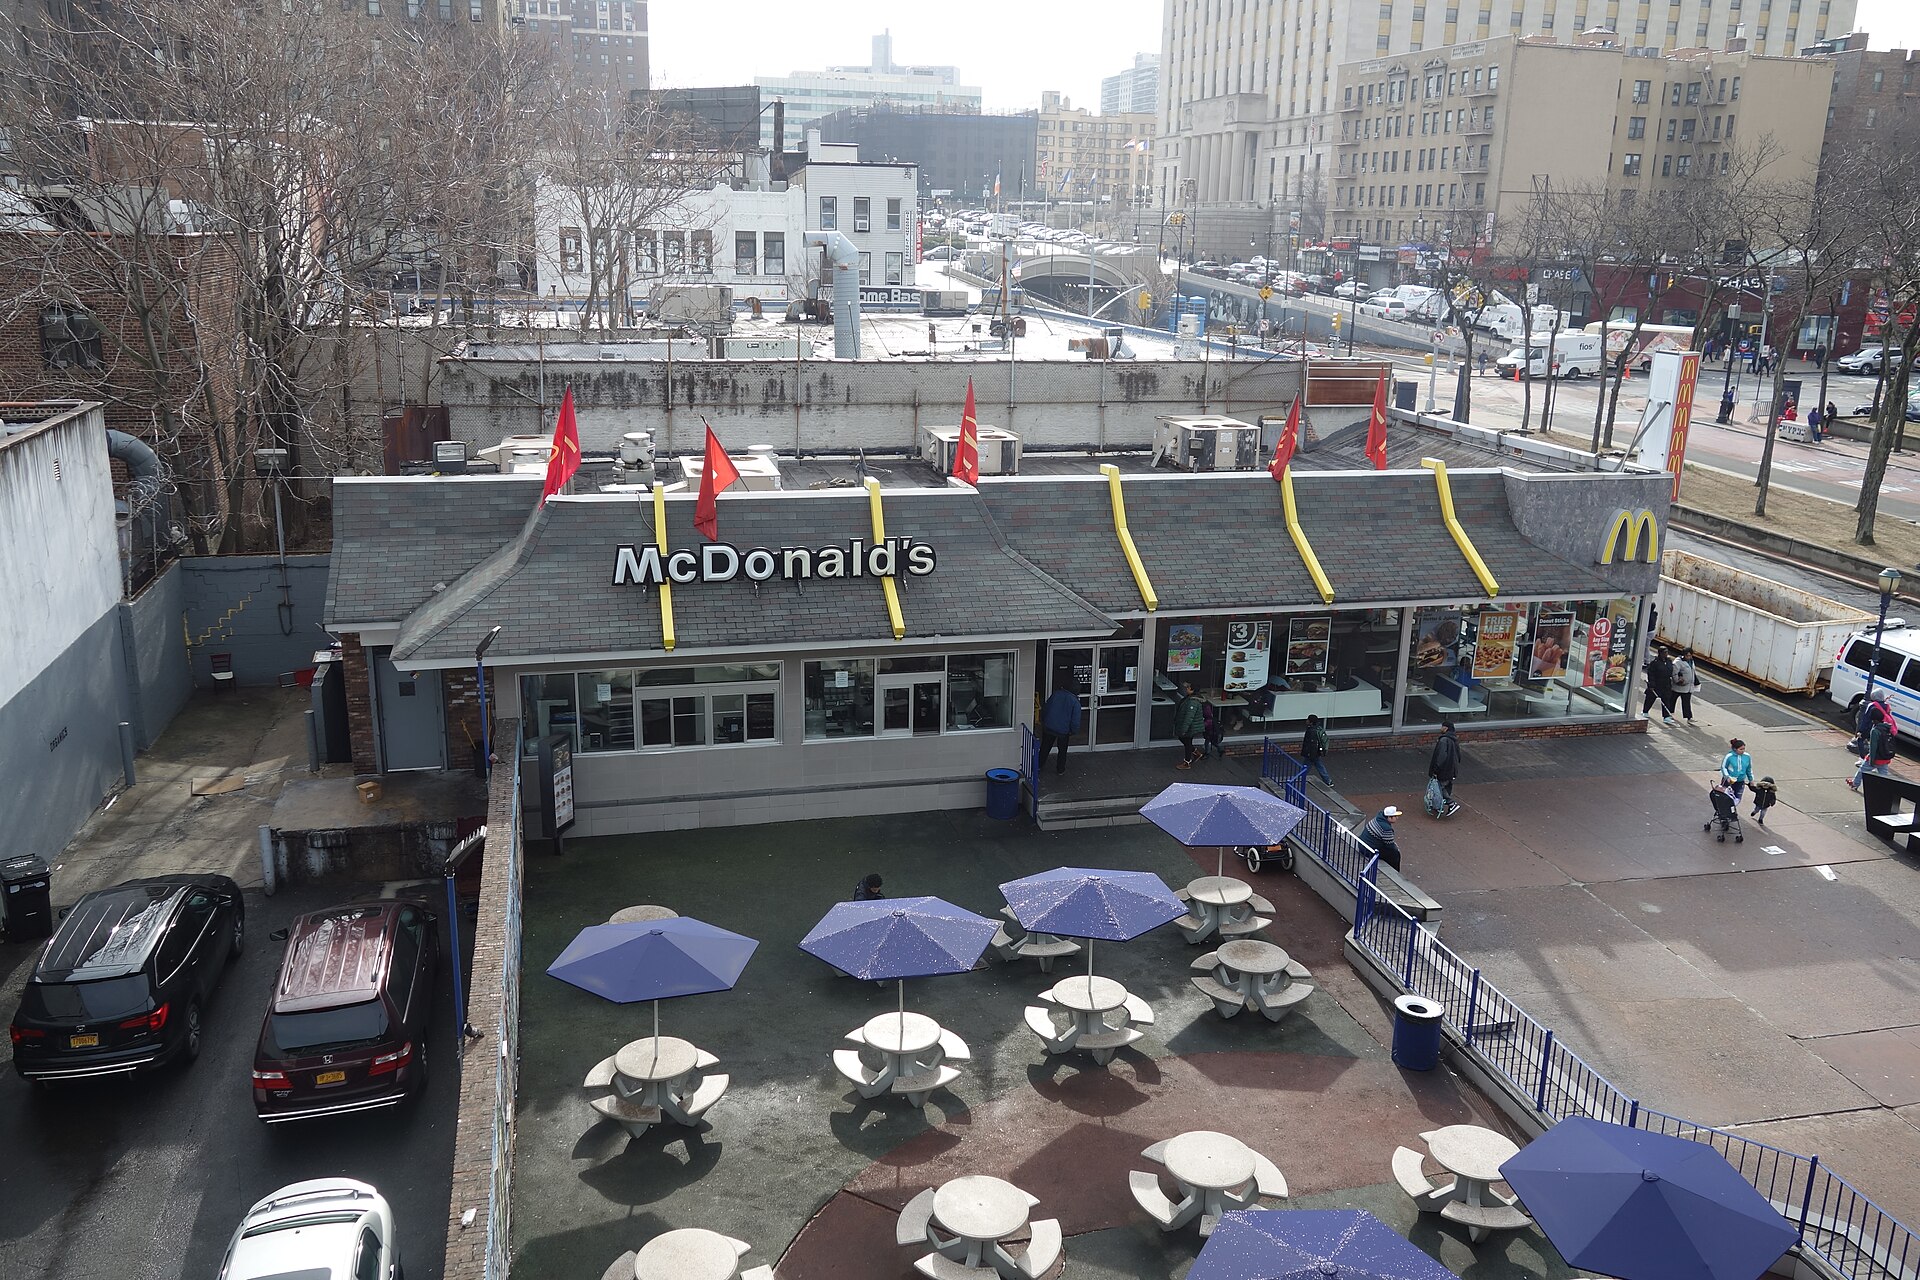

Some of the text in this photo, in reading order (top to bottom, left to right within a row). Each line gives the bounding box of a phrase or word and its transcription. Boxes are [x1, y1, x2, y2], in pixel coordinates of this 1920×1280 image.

[1528, 291, 1537, 299] 25
[1579, 342, 1593, 351] fios
[612, 537, 937, 585] McDonald's
[1484, 615, 1514, 625] FRIES
[1231, 623, 1248, 639] $3
[1483, 624, 1512, 634] MEET
